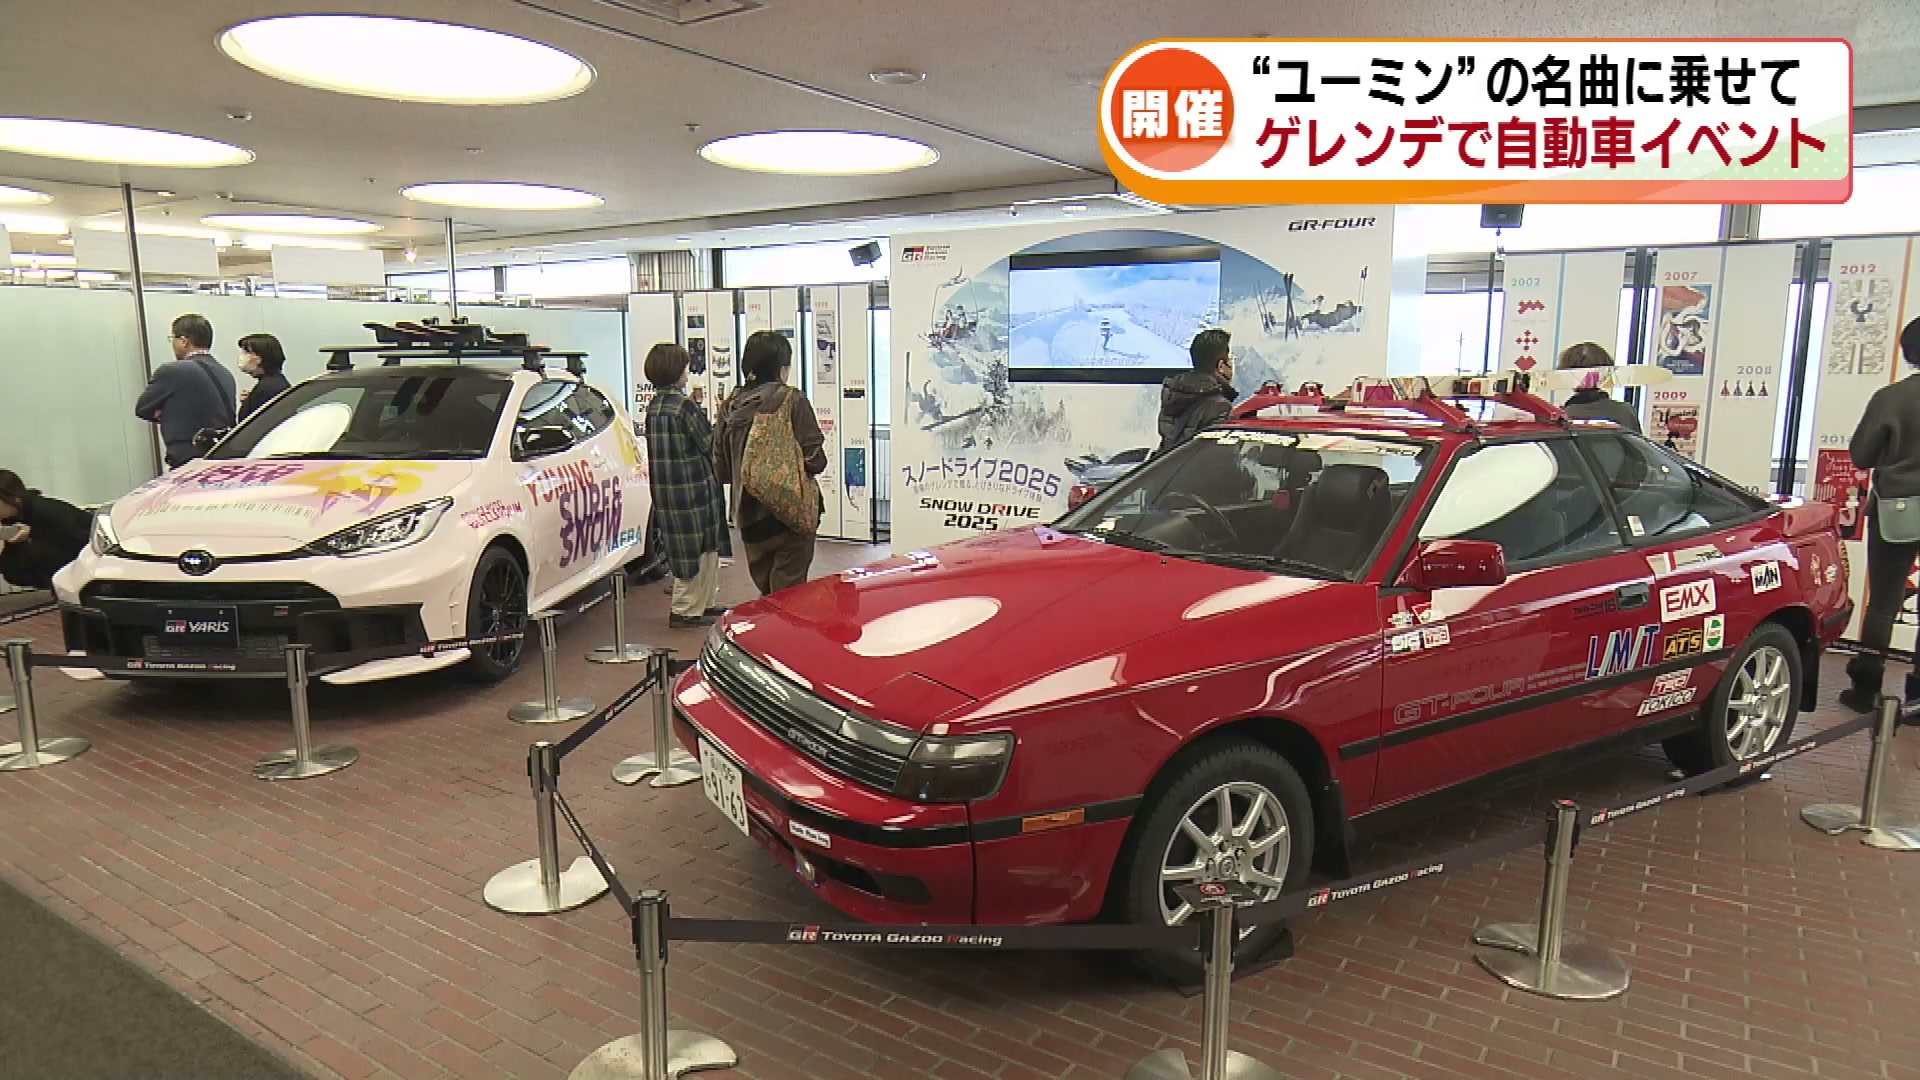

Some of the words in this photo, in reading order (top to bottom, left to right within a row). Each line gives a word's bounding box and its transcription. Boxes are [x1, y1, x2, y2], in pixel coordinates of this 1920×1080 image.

[1664, 271, 1698, 282] 2007
[1839, 264, 1876, 276] 2012
[1653, 391, 1688, 401] 2009
[902, 456, 1061, 498] スノードライブ2025
[919, 497, 974, 513] SNOW
[977, 503, 1041, 519] DRIVE
[944, 513, 998, 531] 2025
[1665, 583, 1711, 613] EMX
[188, 621, 230, 633] YARIS
[1664, 632, 1702, 659] ATS
[788, 925, 820, 942] GR
[821, 931, 882, 943] TOYOTA
[886, 933, 943, 944] GAZOO
[946, 933, 1003, 947] Racing
